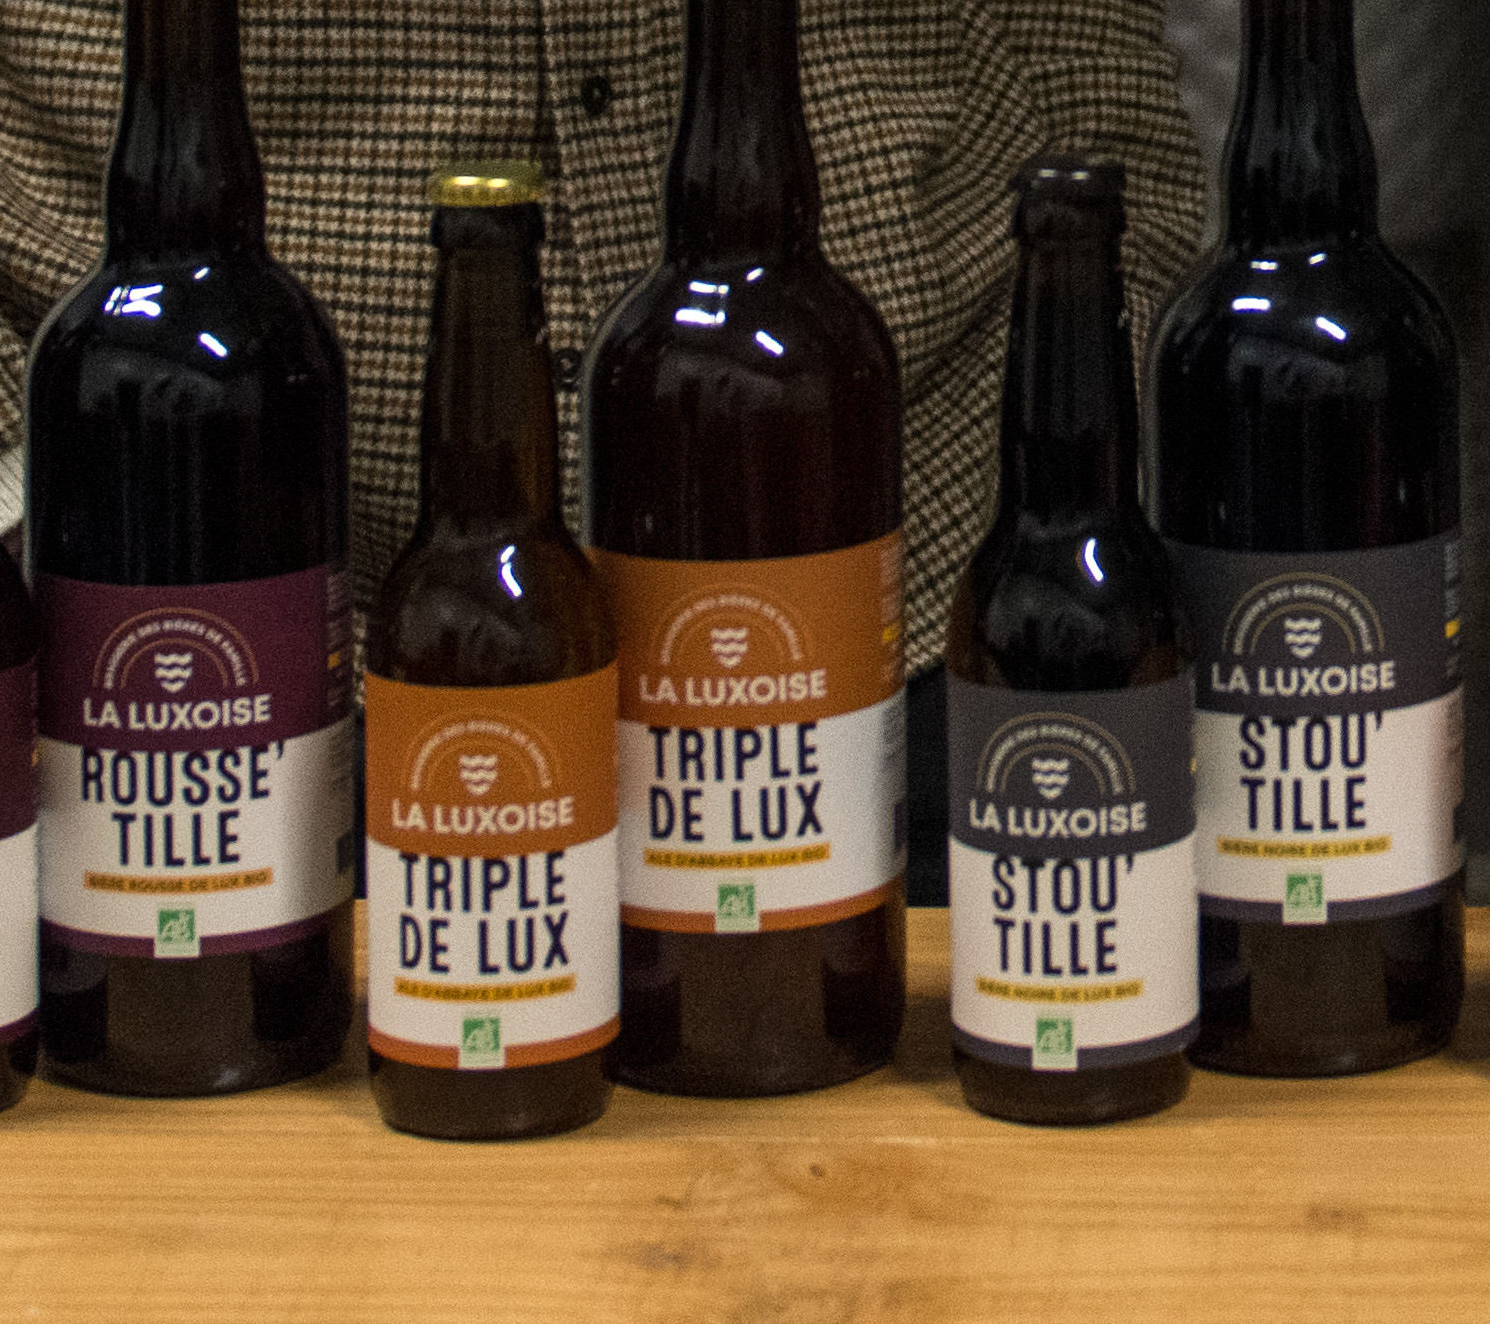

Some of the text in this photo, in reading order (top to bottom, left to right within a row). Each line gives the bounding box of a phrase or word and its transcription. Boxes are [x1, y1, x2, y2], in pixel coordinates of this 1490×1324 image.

[639, 669, 827, 706] LA LUXOISE
[1211, 660, 1396, 696] LA LUXOISE
[83, 694, 271, 731] LA LUXOISE
[648, 722, 819, 782] TRIPLE
[391, 796, 575, 834] LA LUXOISE
[649, 781, 823, 842] DE LUX
[969, 798, 1147, 837] LA LUXOISE
[1240, 775, 1367, 832] TILLE
[111, 809, 240, 867] TILLE
[398, 850, 566, 912] TRIPLE
[400, 910, 569, 975] DE LUX
[993, 916, 1118, 975] TILLE
